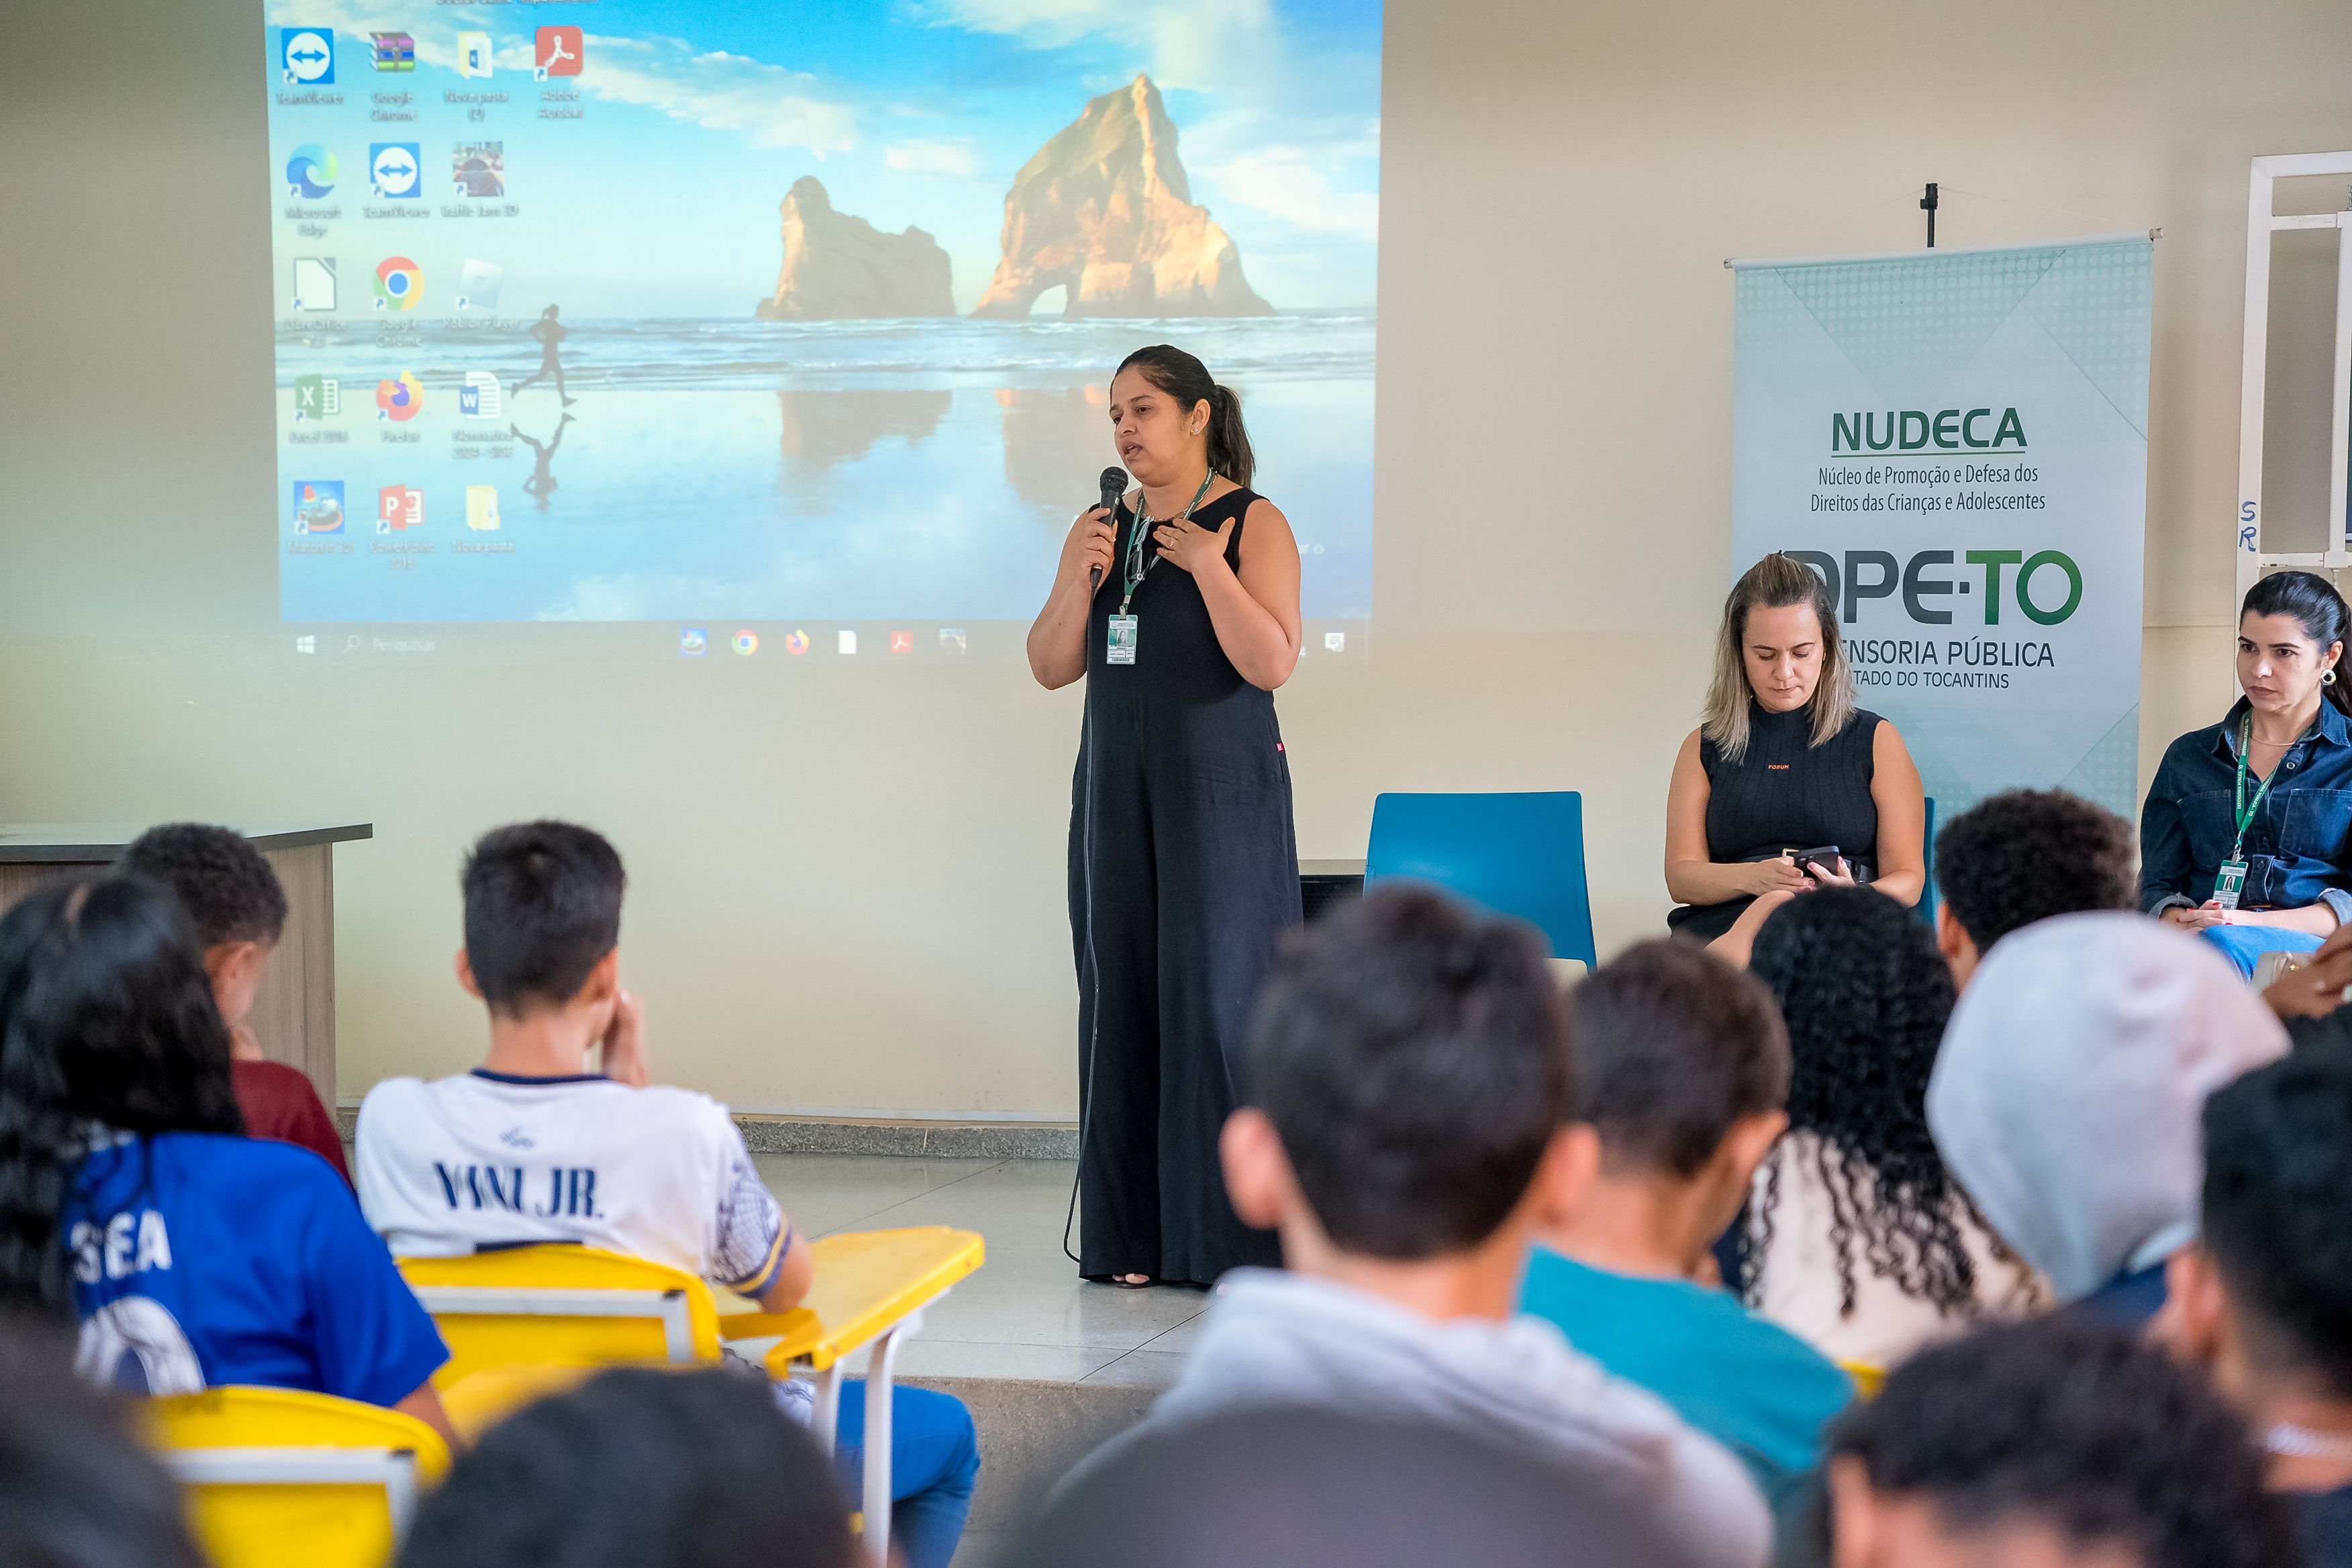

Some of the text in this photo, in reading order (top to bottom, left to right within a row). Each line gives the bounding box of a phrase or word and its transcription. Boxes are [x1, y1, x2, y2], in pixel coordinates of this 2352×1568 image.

[1832, 407, 2028, 452] NUDECA
[1819, 463, 2038, 489] Núcleo de Promoção e Defesa dos
[1811, 491, 2045, 516] Direitos das Crianças e Adolescentes
[1843, 636, 2055, 667] NSORIA PÚBLICA
[1852, 670, 2009, 689] TADO DO TOCANTINS
